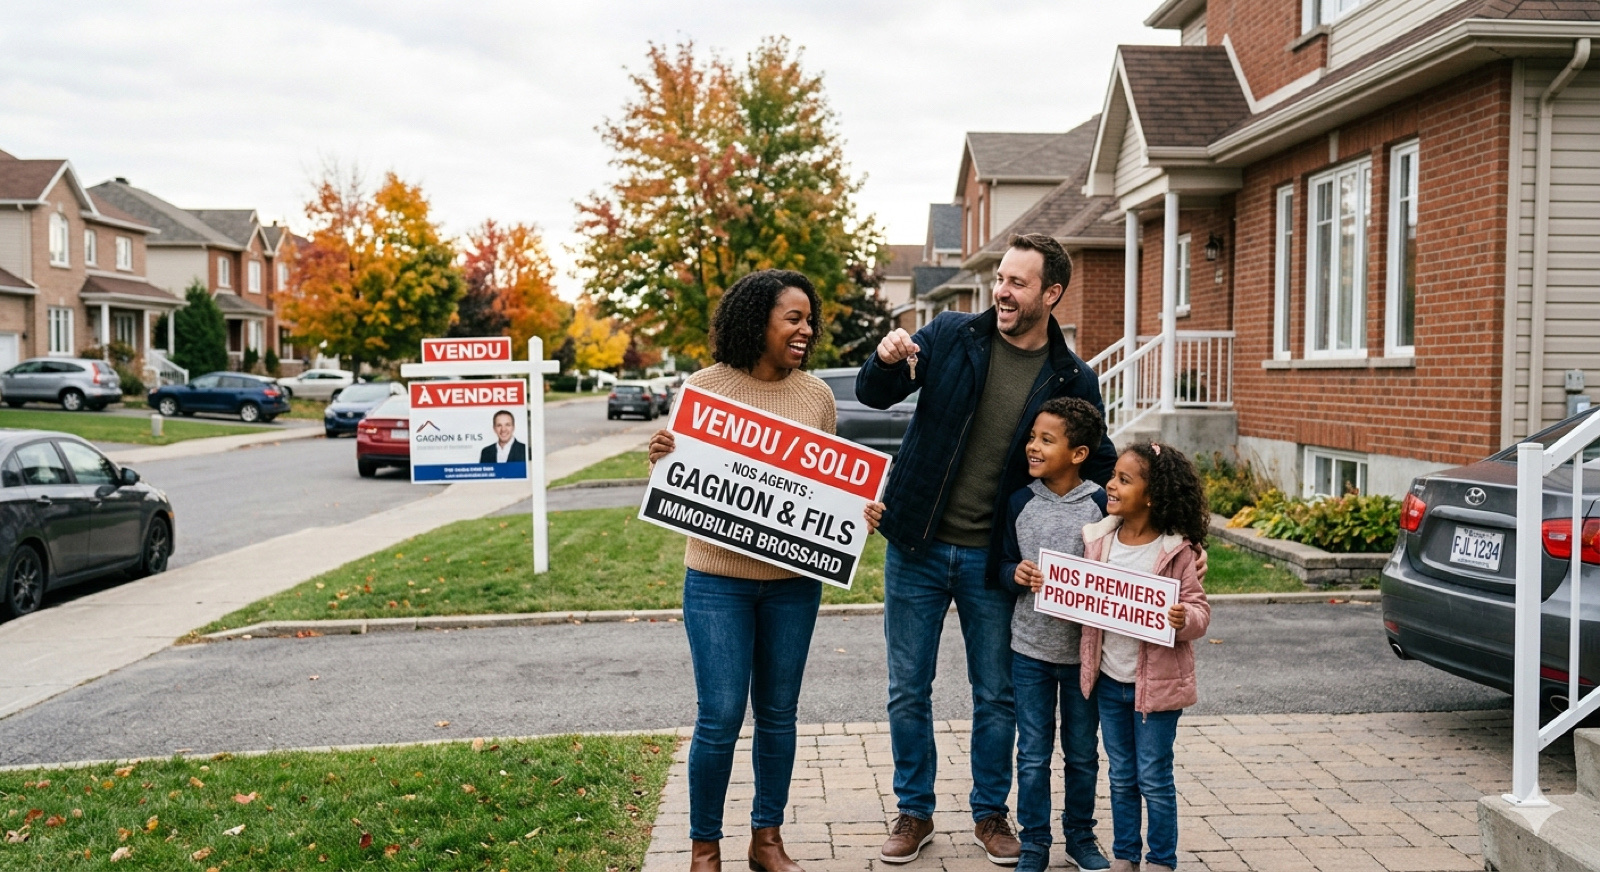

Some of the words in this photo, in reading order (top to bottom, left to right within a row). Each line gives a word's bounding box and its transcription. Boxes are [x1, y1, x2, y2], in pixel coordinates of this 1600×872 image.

[431, 342, 502, 360] VENDU
[417, 385, 433, 405] À
[437, 386, 518, 405] VENDRE
[416, 434, 455, 443] GAGNON
[465, 433, 483, 441] FILS
[692, 402, 782, 455] VENDU
[782, 436, 800, 461] /
[800, 442, 871, 486] SOLD
[731, 461, 758, 480] NOS
[758, 471, 808, 499] AGENTS
[666, 461, 775, 518] GAGNON
[776, 500, 797, 528] &
[800, 507, 856, 546] FILS
[657, 498, 754, 545] IMMOBILIER
[756, 532, 842, 575] BROSSARD
[1044, 585, 1166, 631] PROPRIÉTAIRES
[1049, 563, 1081, 587] NOS
[1084, 573, 1166, 608] PREMIERS
